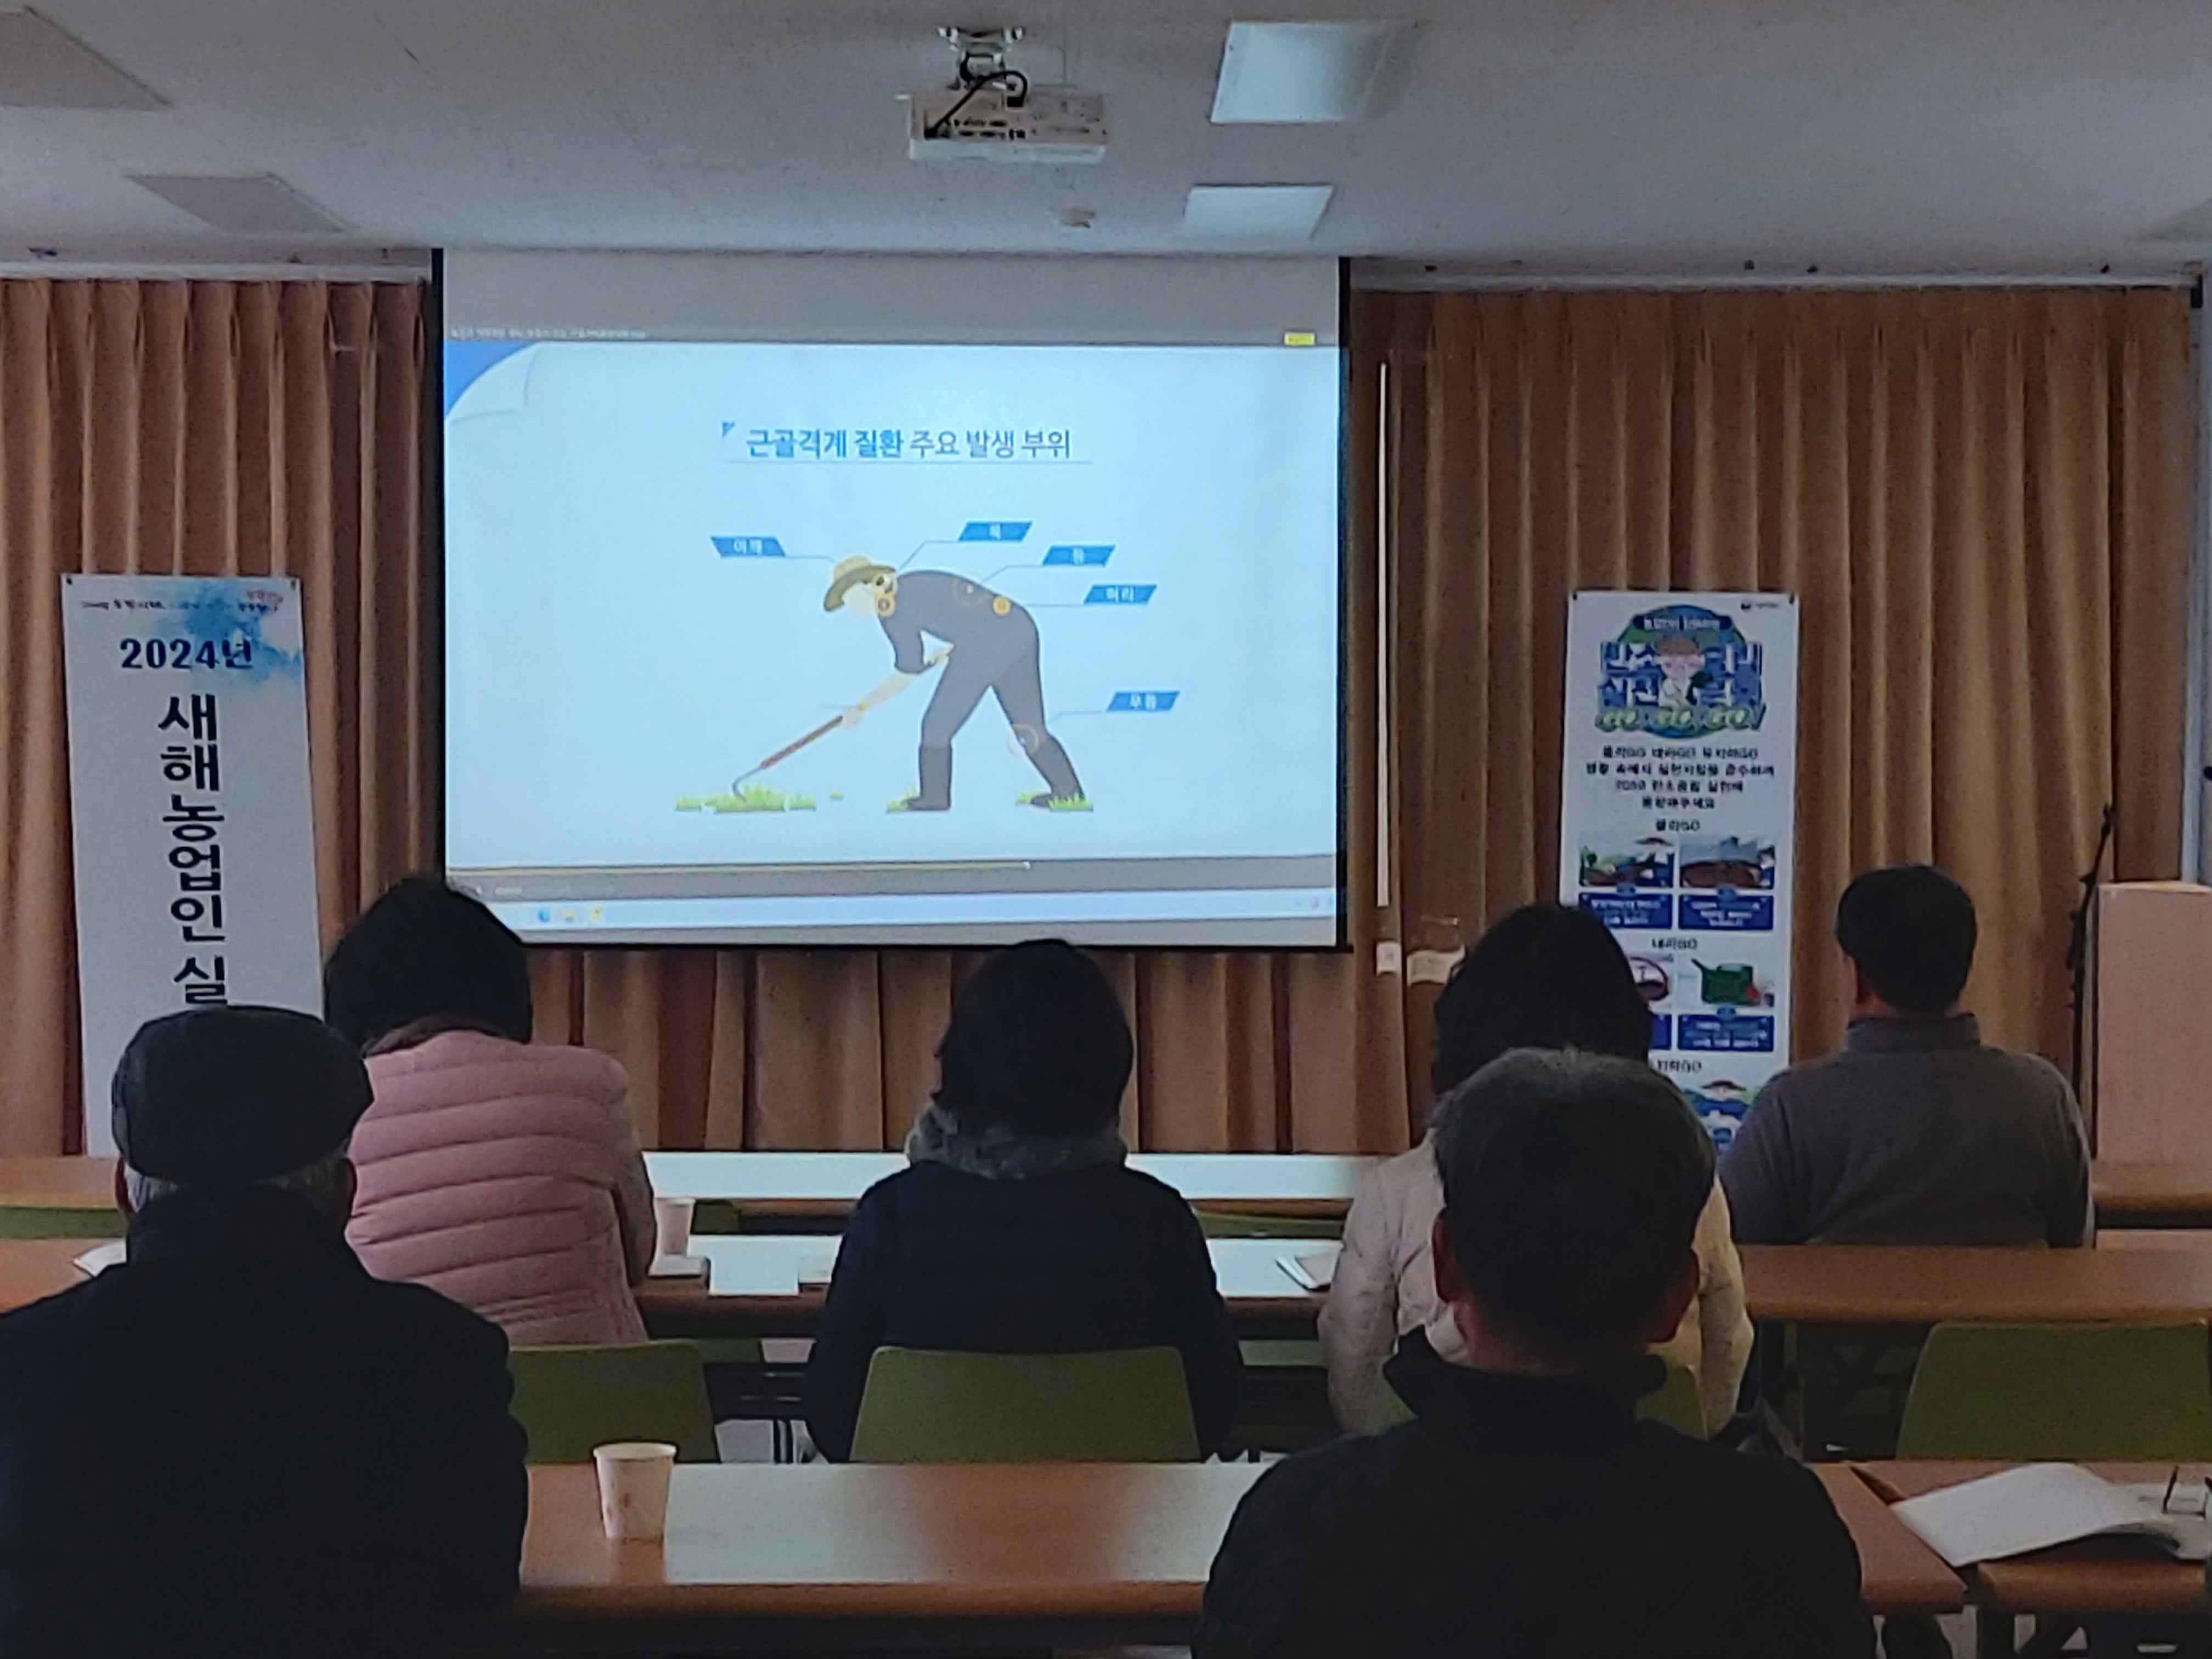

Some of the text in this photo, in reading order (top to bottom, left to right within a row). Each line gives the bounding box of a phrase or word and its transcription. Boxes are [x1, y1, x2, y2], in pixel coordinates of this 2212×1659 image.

[854, 428, 904, 459] 질환
[910, 430, 960, 459] 주요
[966, 428, 1014, 459] 발생
[1022, 428, 1071, 459] 부위
[120, 638, 253, 669] 2024년
